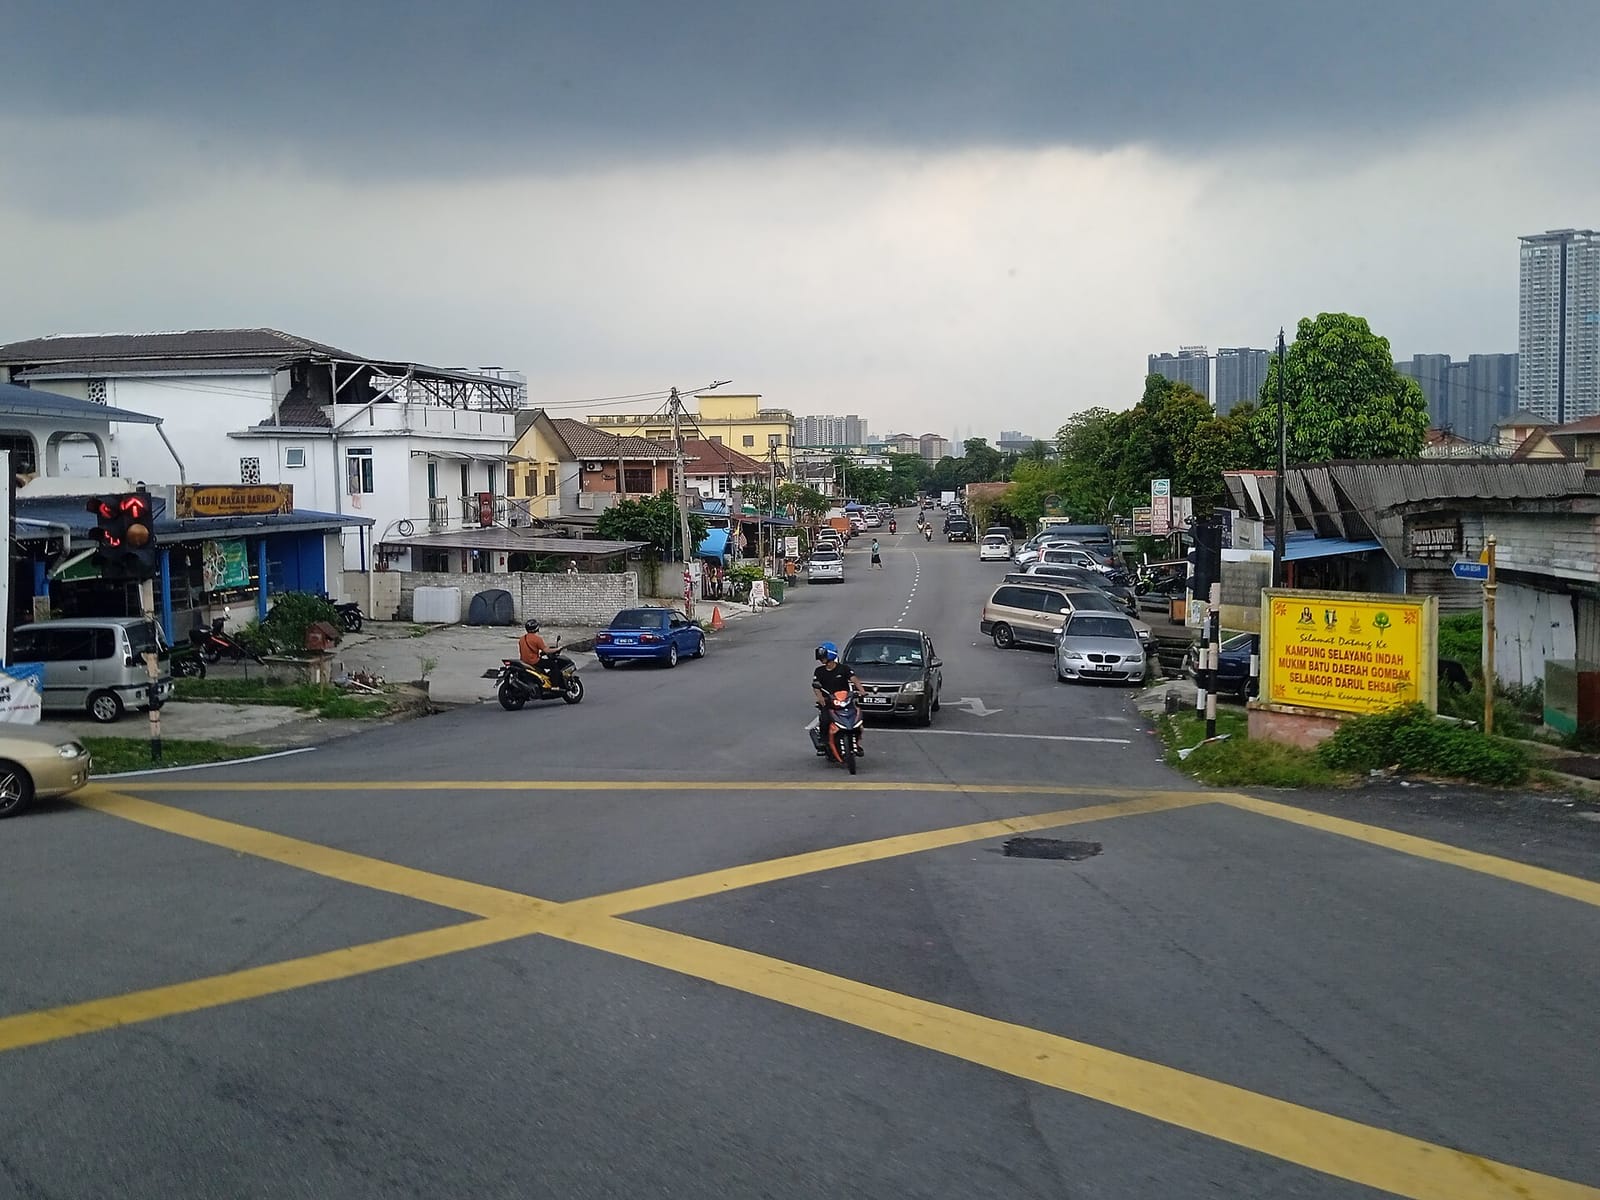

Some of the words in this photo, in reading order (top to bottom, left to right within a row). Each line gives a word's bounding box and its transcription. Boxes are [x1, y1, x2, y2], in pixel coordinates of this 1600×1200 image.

[197, 495, 218, 505] KEDAI
[220, 495, 246, 505] MAKAN
[1299, 633, 1335, 645] Selamat
[1338, 637, 1372, 650] Datang
[1376, 640, 1388, 649] Ke
[1285, 644, 1326, 659] KAMPUNG
[1328, 649, 1373, 663] SELAYANG
[1375, 653, 1404, 666] INDAH
[1279, 657, 1306, 670] MUKIM
[1309, 661, 1330, 673] BATU
[1332, 663, 1369, 677] DAERAH
[1371, 667, 1411, 681] GOMBAK
[1289, 672, 1334, 687] SELANGOR
[1335, 677, 1364, 690] DARUL
[1367, 681, 1398, 693] EHSAN
